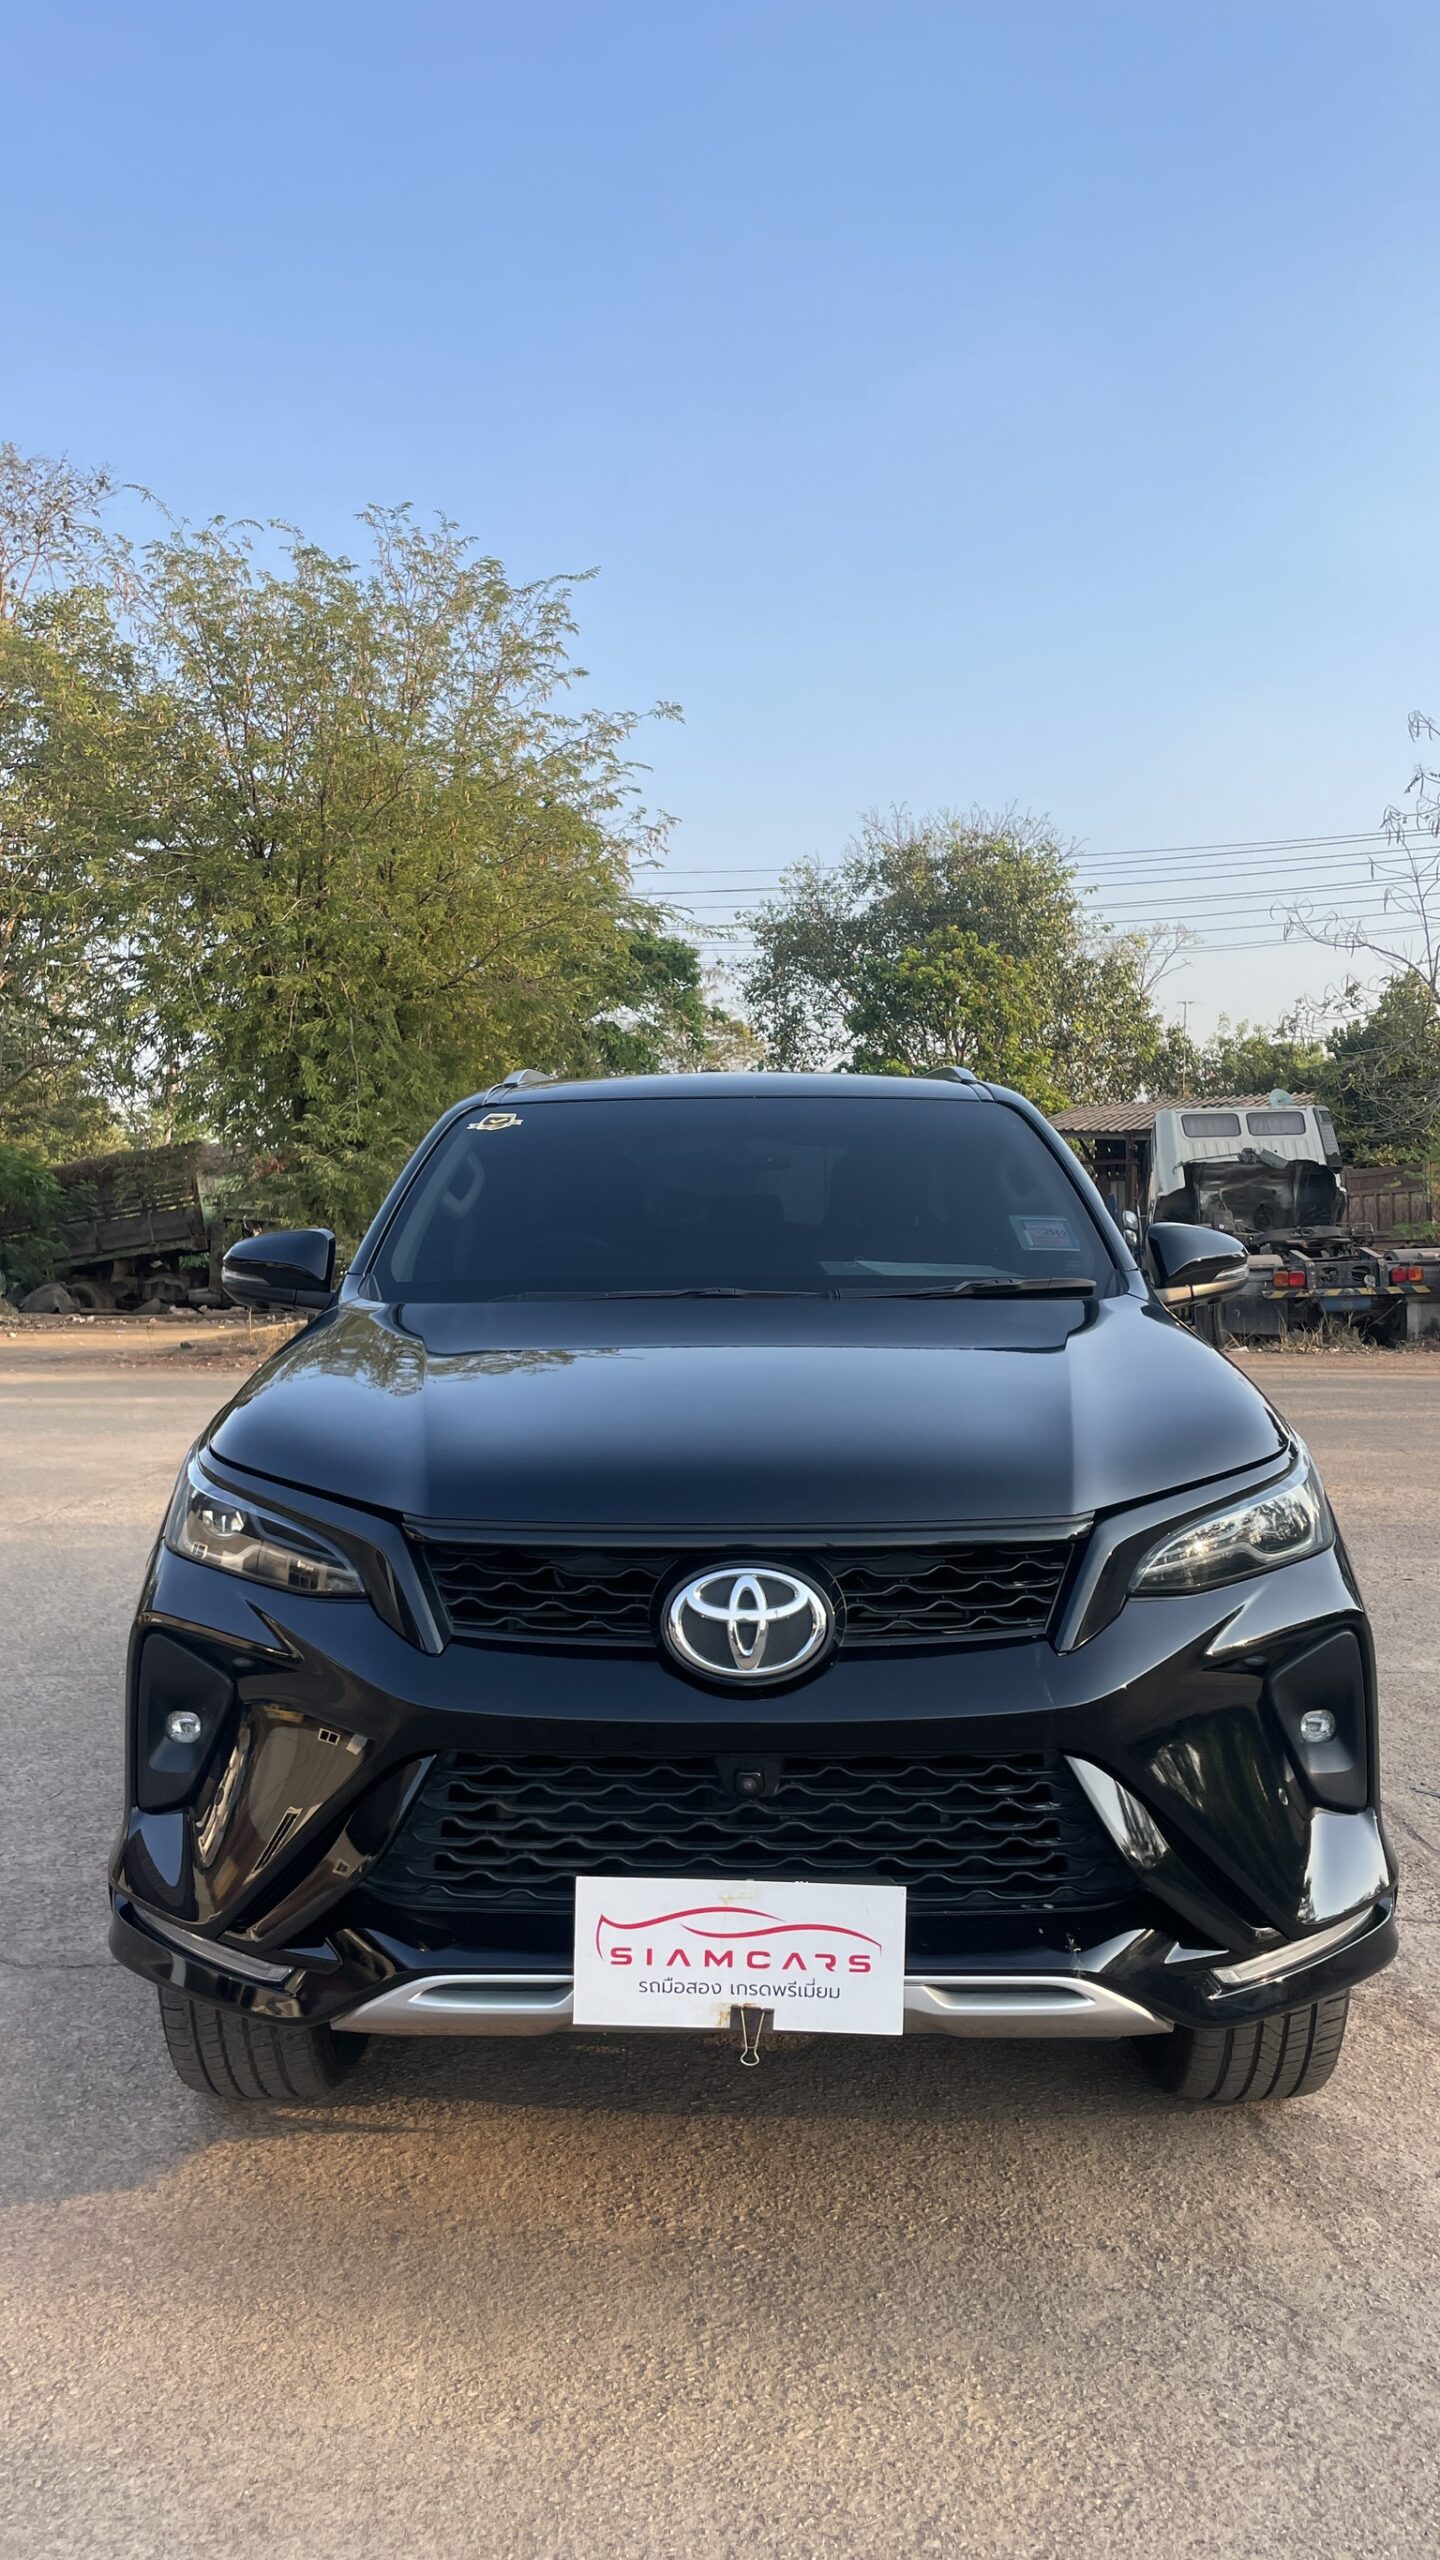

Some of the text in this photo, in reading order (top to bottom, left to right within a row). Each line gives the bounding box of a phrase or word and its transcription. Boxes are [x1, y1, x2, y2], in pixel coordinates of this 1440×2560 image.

[610, 1947, 871, 1973] SIAMCARS
[638, 1977, 841, 1999] รถมือสอง เกรดพรีเมี่ยม
